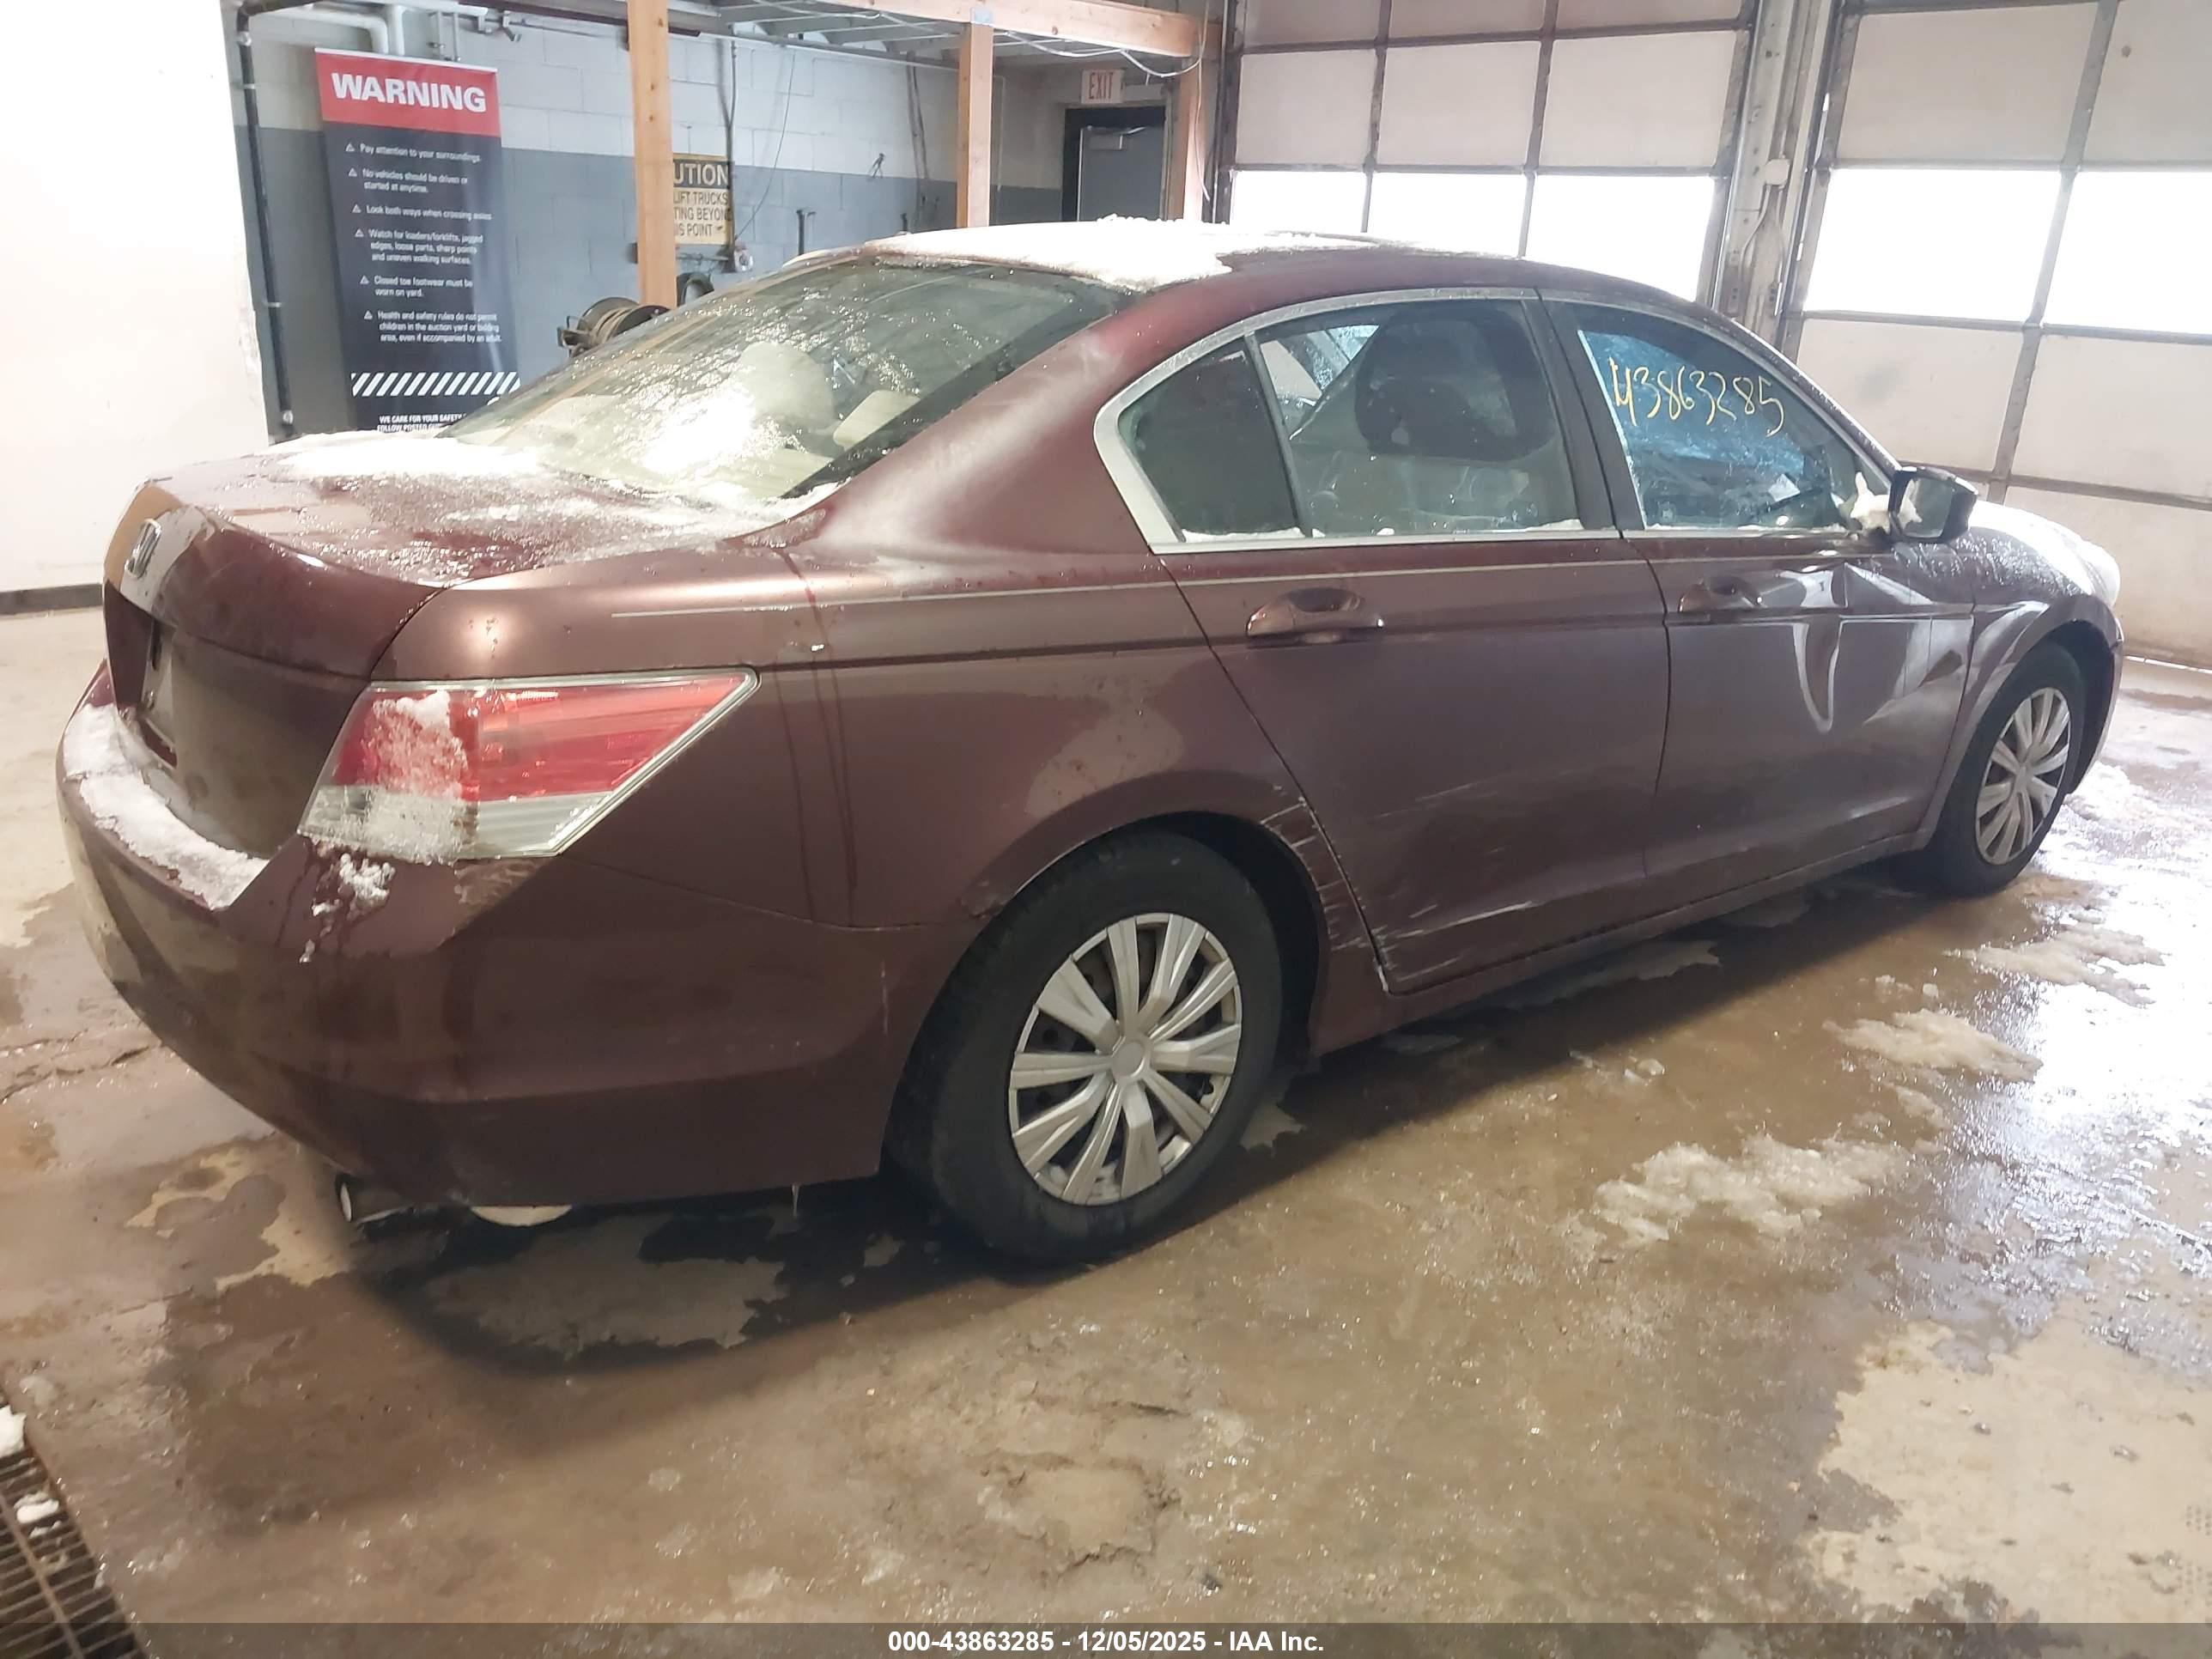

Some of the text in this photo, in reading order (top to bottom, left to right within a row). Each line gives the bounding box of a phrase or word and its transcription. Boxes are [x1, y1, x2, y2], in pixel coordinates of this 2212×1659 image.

[331, 72, 487, 112] WARNING
[1089, 71, 1114, 100] EXIT
[360, 143, 374, 155] Pay
[375, 146, 408, 156] attention
[409, 149, 417, 157] to
[418, 150, 434, 159] your
[362, 167, 374, 179] No
[375, 170, 404, 180] vehicles
[404, 172, 428, 182] should
[428, 173, 438, 183] be
[438, 174, 460, 184] driven
[673, 163, 728, 185] UTION
[363, 181, 390, 191] started
[693, 191, 728, 205] TRUCKS
[366, 204, 384, 215] Look
[385, 206, 402, 216] both
[403, 209, 422, 218] ways
[422, 209, 442, 217] when
[443, 210, 472, 222] crossing
[368, 228, 393, 239] Watch
[393, 230, 404, 239] for
[461, 234, 483, 244] jagged
[687, 223, 713, 237] POINT
[394, 241, 414, 251] loose
[436, 244, 456, 254] sharp
[456, 246, 477, 254] points
[372, 252, 386, 261] and
[412, 254, 441, 265] walking
[374, 275, 473, 288] Closed toe footwear must be
[377, 310, 401, 320] Health
[401, 311, 415, 320] and
[416, 311, 437, 322] safety
[438, 312, 454, 321] rules
[455, 313, 465, 321] do
[477, 313, 497, 323] permit
[379, 321, 407, 331] children
[415, 322, 427, 331] the
[428, 324, 453, 332] auction
[453, 323, 468, 333] yard
[477, 323, 500, 333] bidding
[398, 334, 416, 343] even
[422, 334, 466, 343] accompanied
[466, 334, 476, 344] by
[1608, 356, 1784, 438] 43863285
[379, 415, 392, 424] WE
[392, 415, 409, 423] CARE
[409, 414, 422, 423] FOR
[422, 414, 439, 422] YOUR
